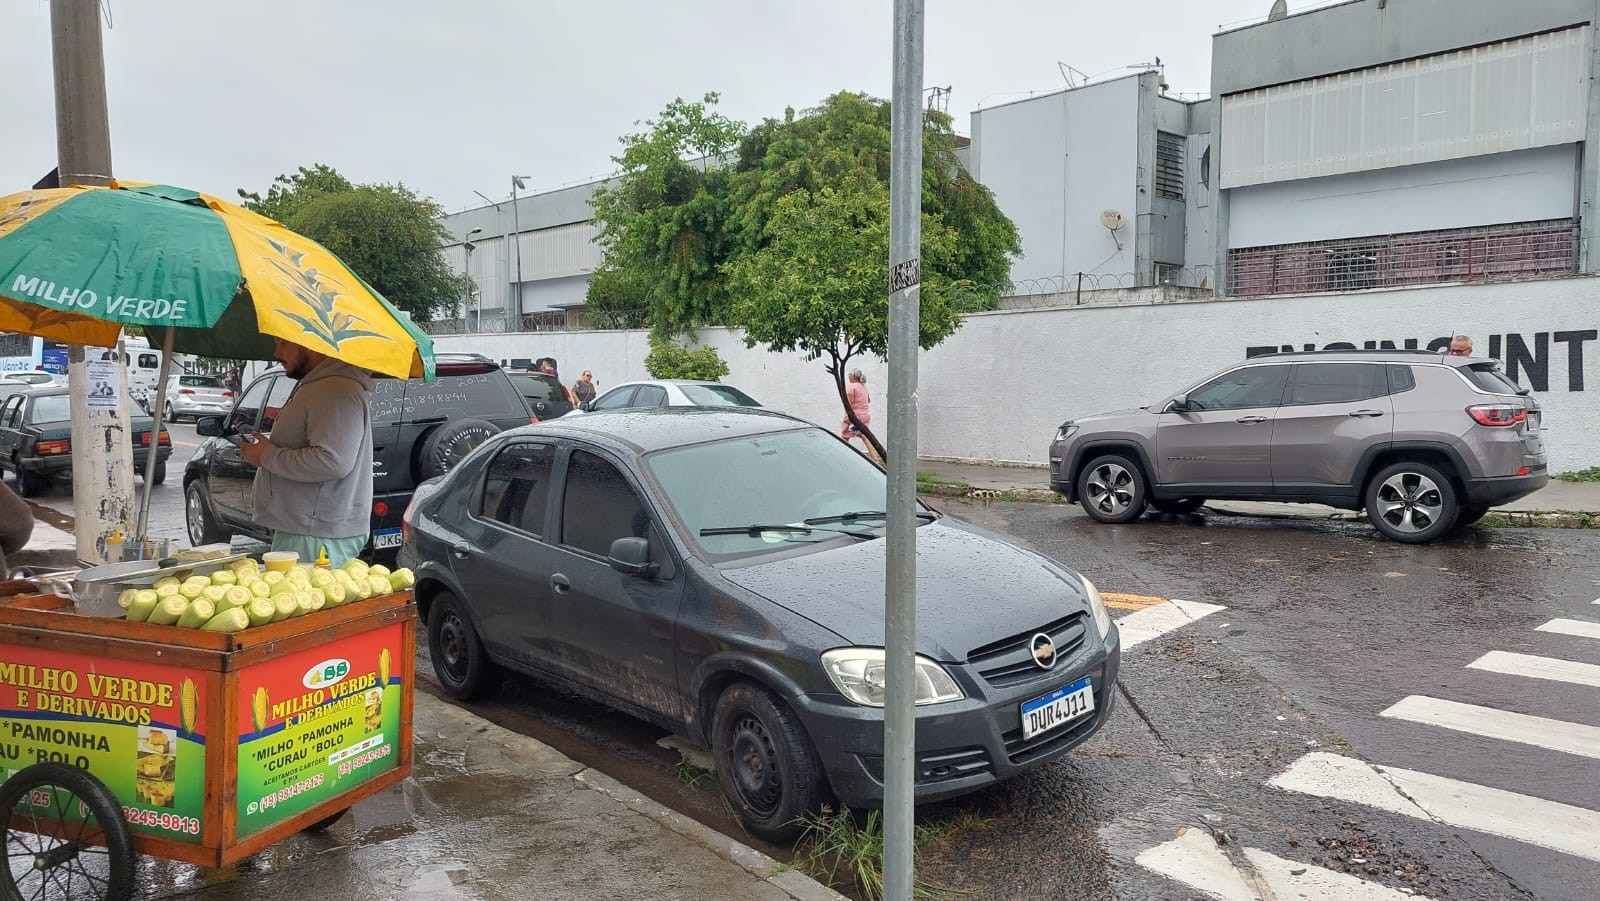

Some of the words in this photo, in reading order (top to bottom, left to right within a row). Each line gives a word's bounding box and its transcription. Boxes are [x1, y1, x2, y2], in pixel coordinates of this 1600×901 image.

[12, 274, 97, 308] MILHO
[106, 295, 187, 319] VERDE
[0, 661, 78, 694] MILHO
[86, 672, 174, 708] VERDE
[271, 689, 325, 721] MILHO
[329, 671, 377, 700] VERDE
[16, 689, 29, 708] E
[36, 692, 151, 726] DERIVADOS
[284, 716, 294, 730] E
[297, 692, 366, 724] DERIVADOS
[1029, 690, 1087, 733] DUR4J11
[121, 806, 200, 835] 8245-9813
[260, 792, 278, 813] (19)
